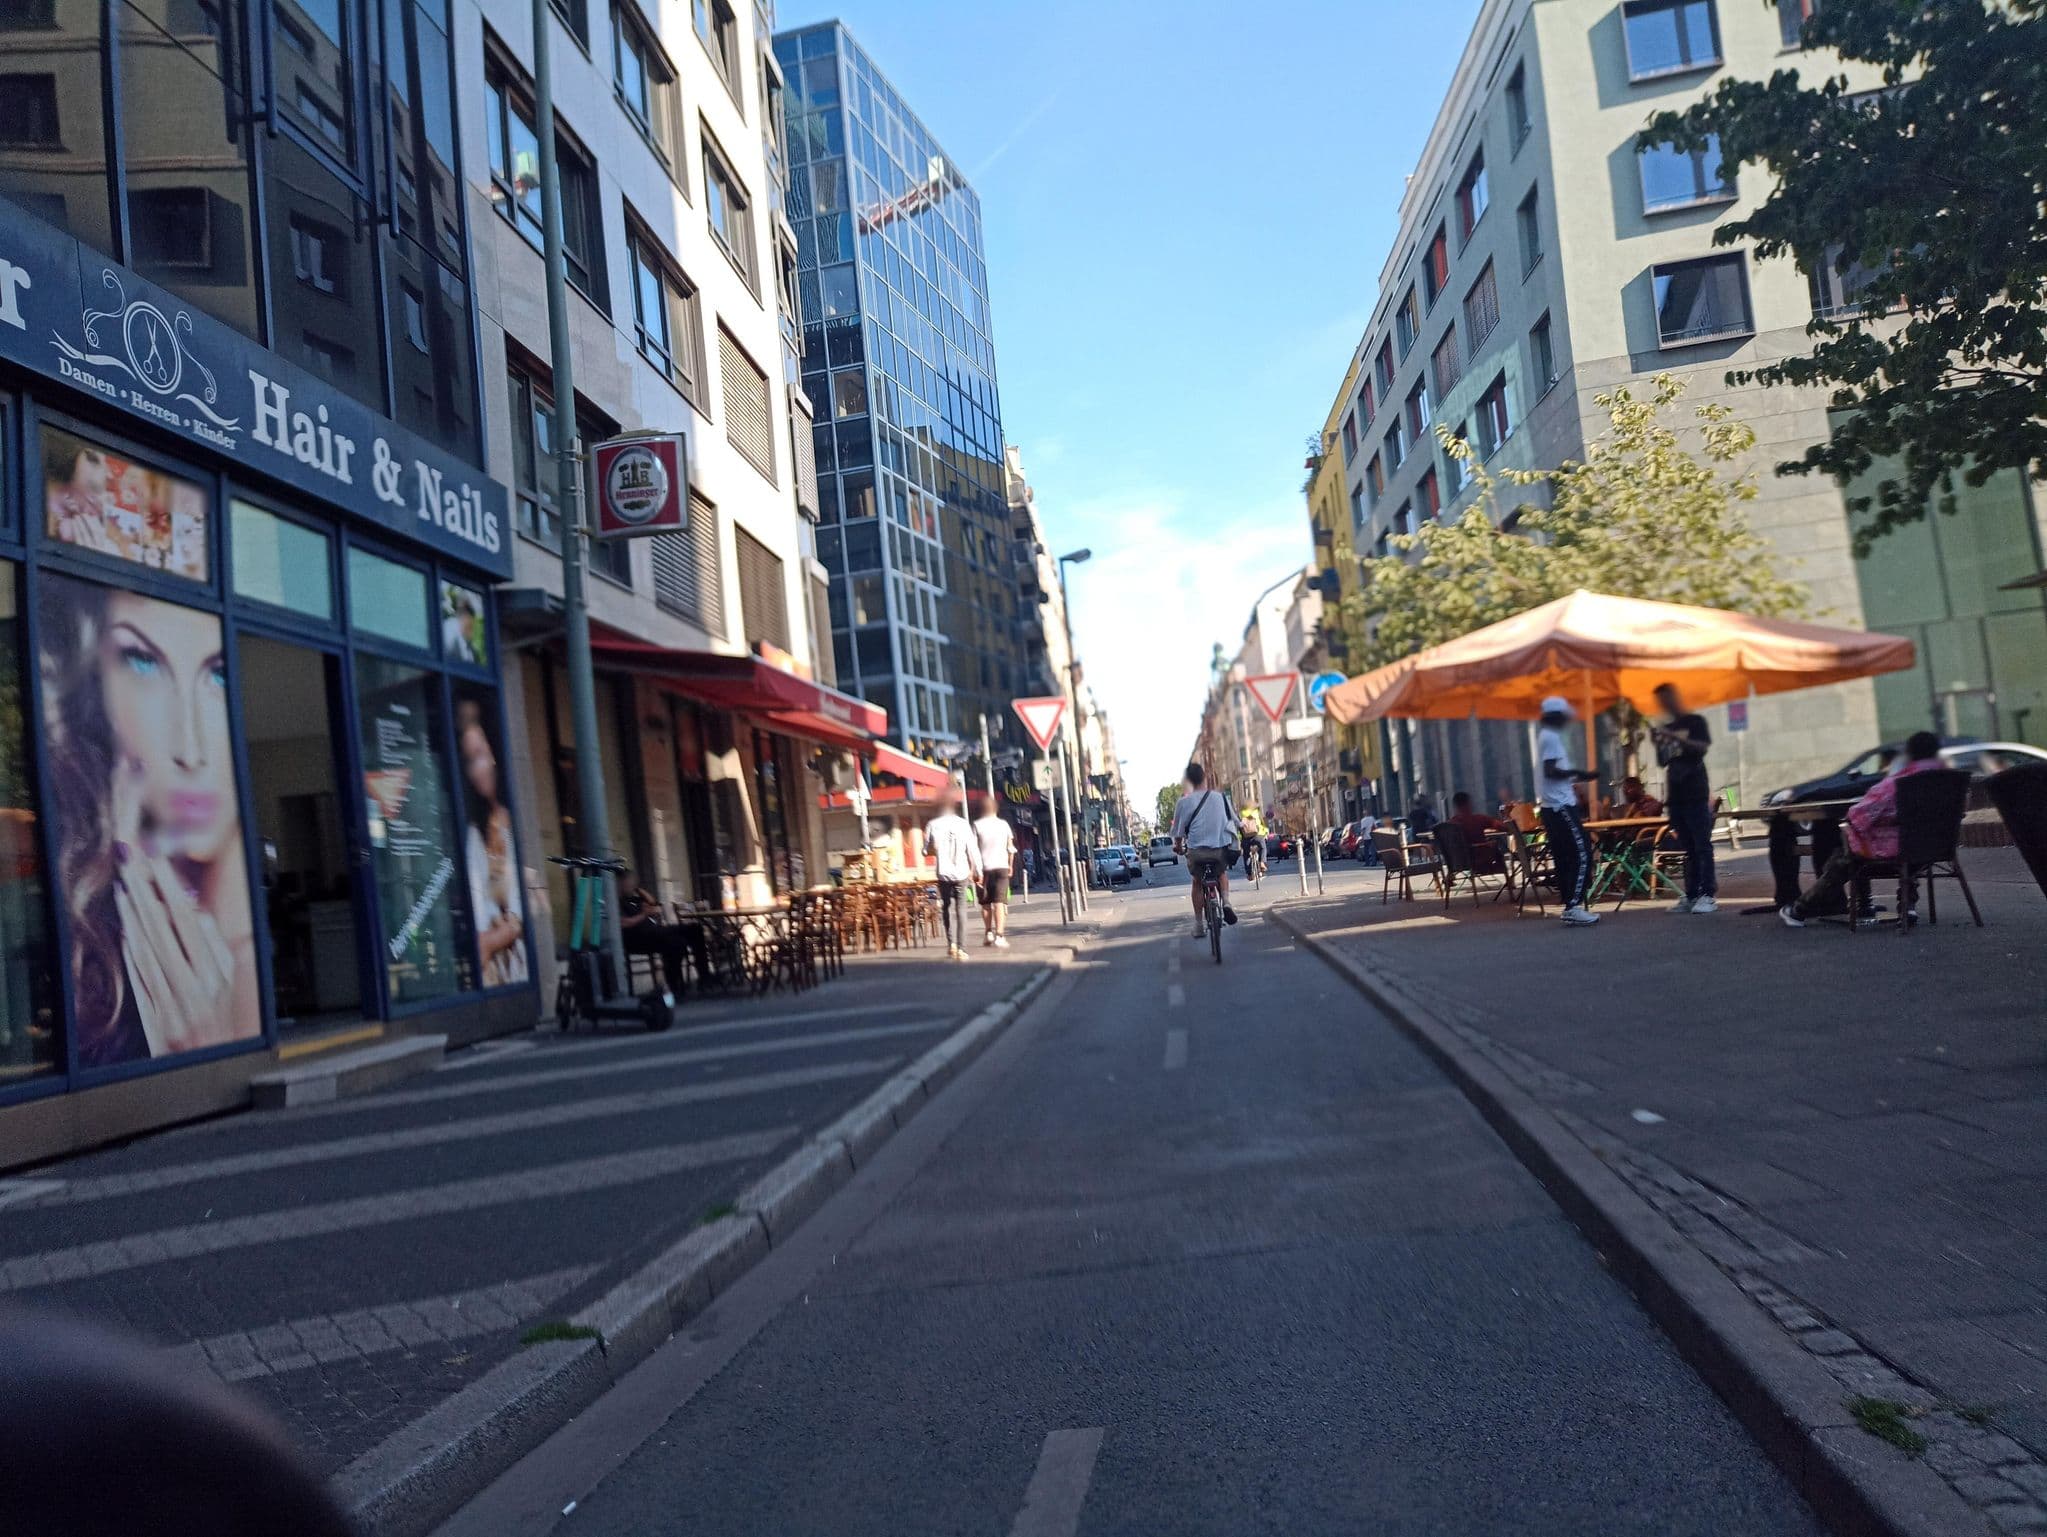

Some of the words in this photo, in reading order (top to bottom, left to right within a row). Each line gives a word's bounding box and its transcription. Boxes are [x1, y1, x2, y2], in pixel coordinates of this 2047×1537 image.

[58, 357, 116, 398] Damen
[130, 390, 181, 426] Herren
[193, 419, 237, 450] Kinder
[249, 369, 356, 484] Hair
[372, 437, 406, 507] &
[415, 459, 500, 553] Nails
